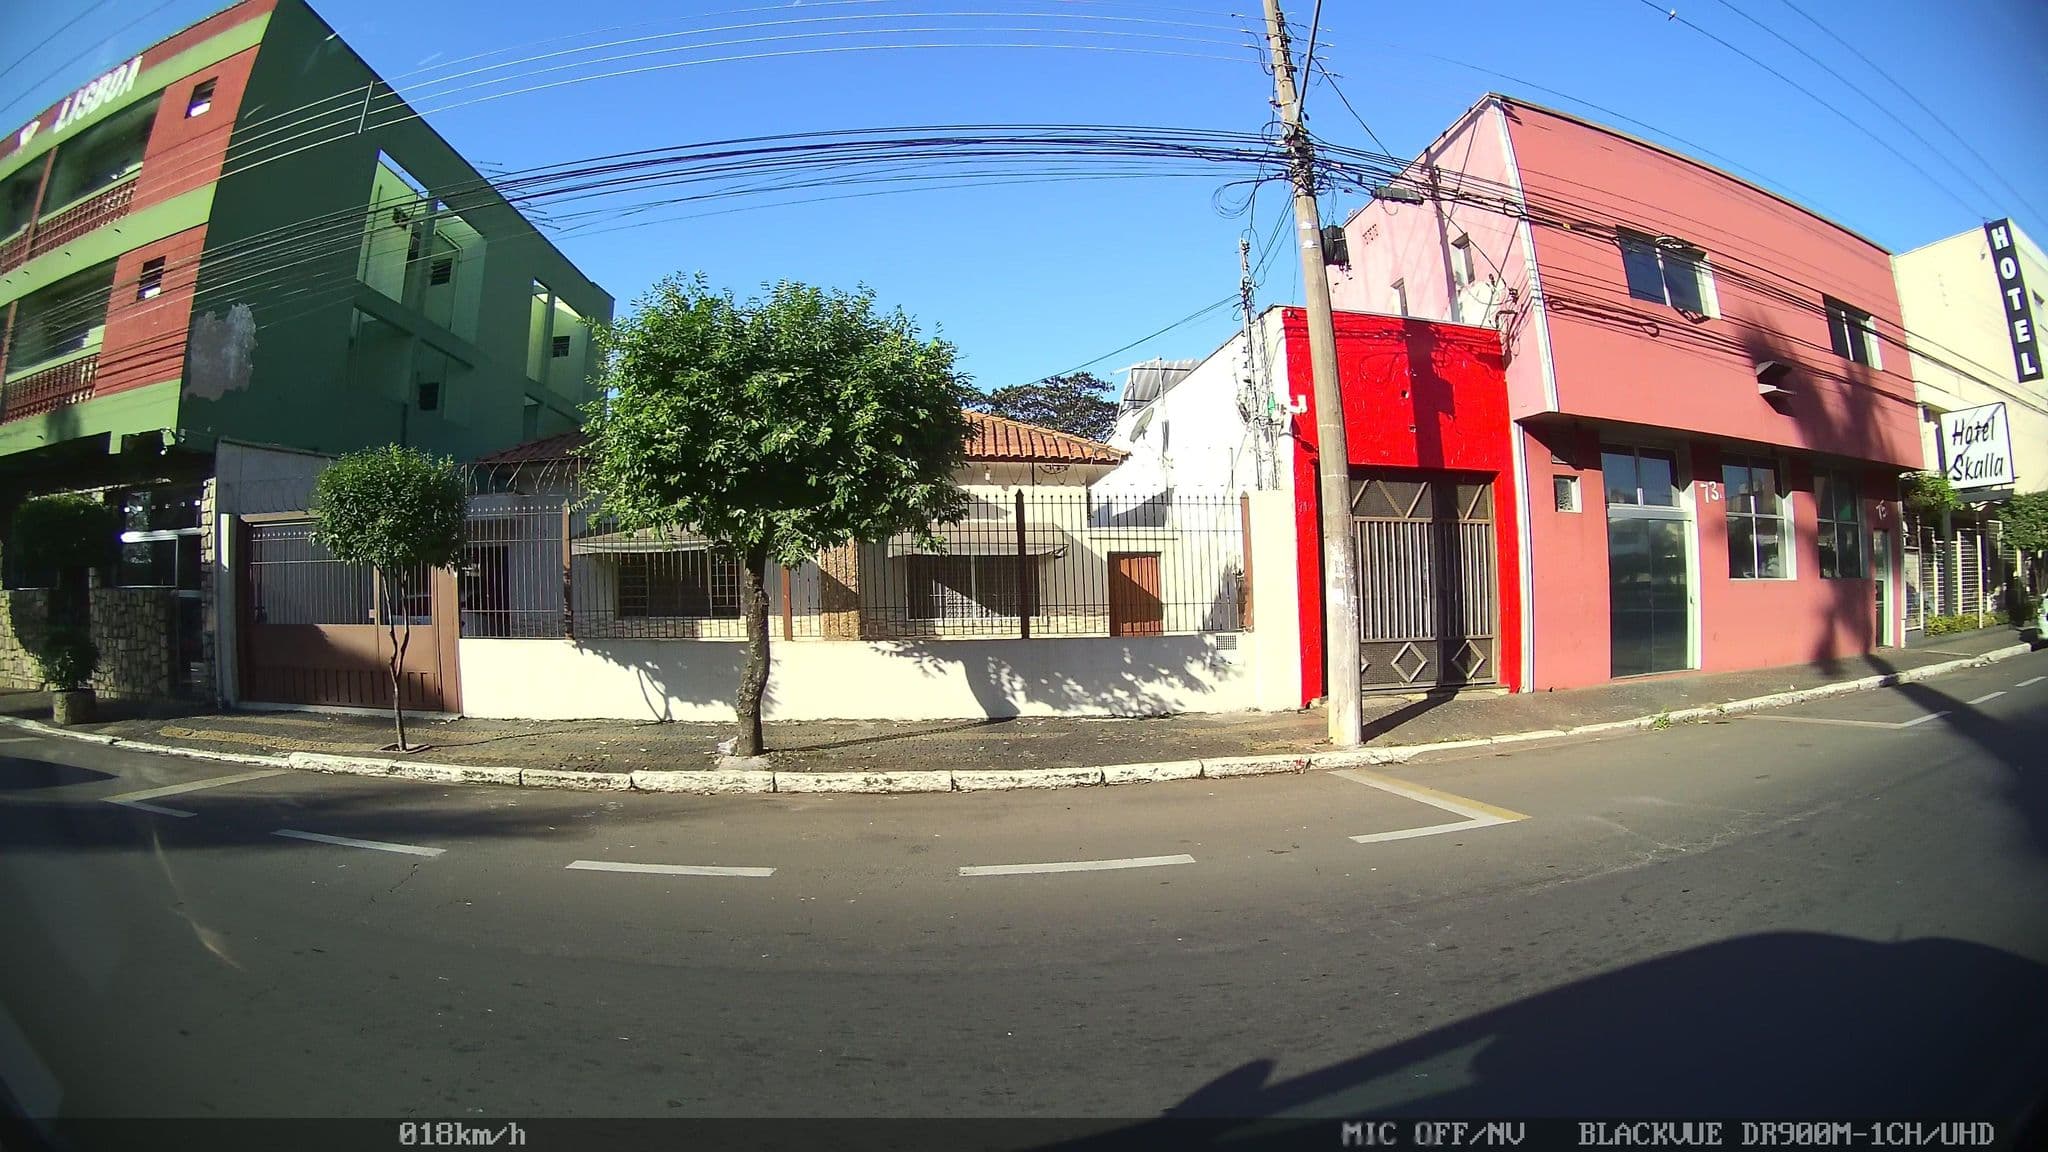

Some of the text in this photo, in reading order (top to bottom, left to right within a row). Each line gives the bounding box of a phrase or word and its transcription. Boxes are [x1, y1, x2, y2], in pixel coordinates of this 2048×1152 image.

[53, 55, 143, 134] LISBOA
[1990, 225, 2037, 377] HOTEL
[1952, 415, 1995, 446] Hotel
[1952, 452, 2004, 481] Skalla
